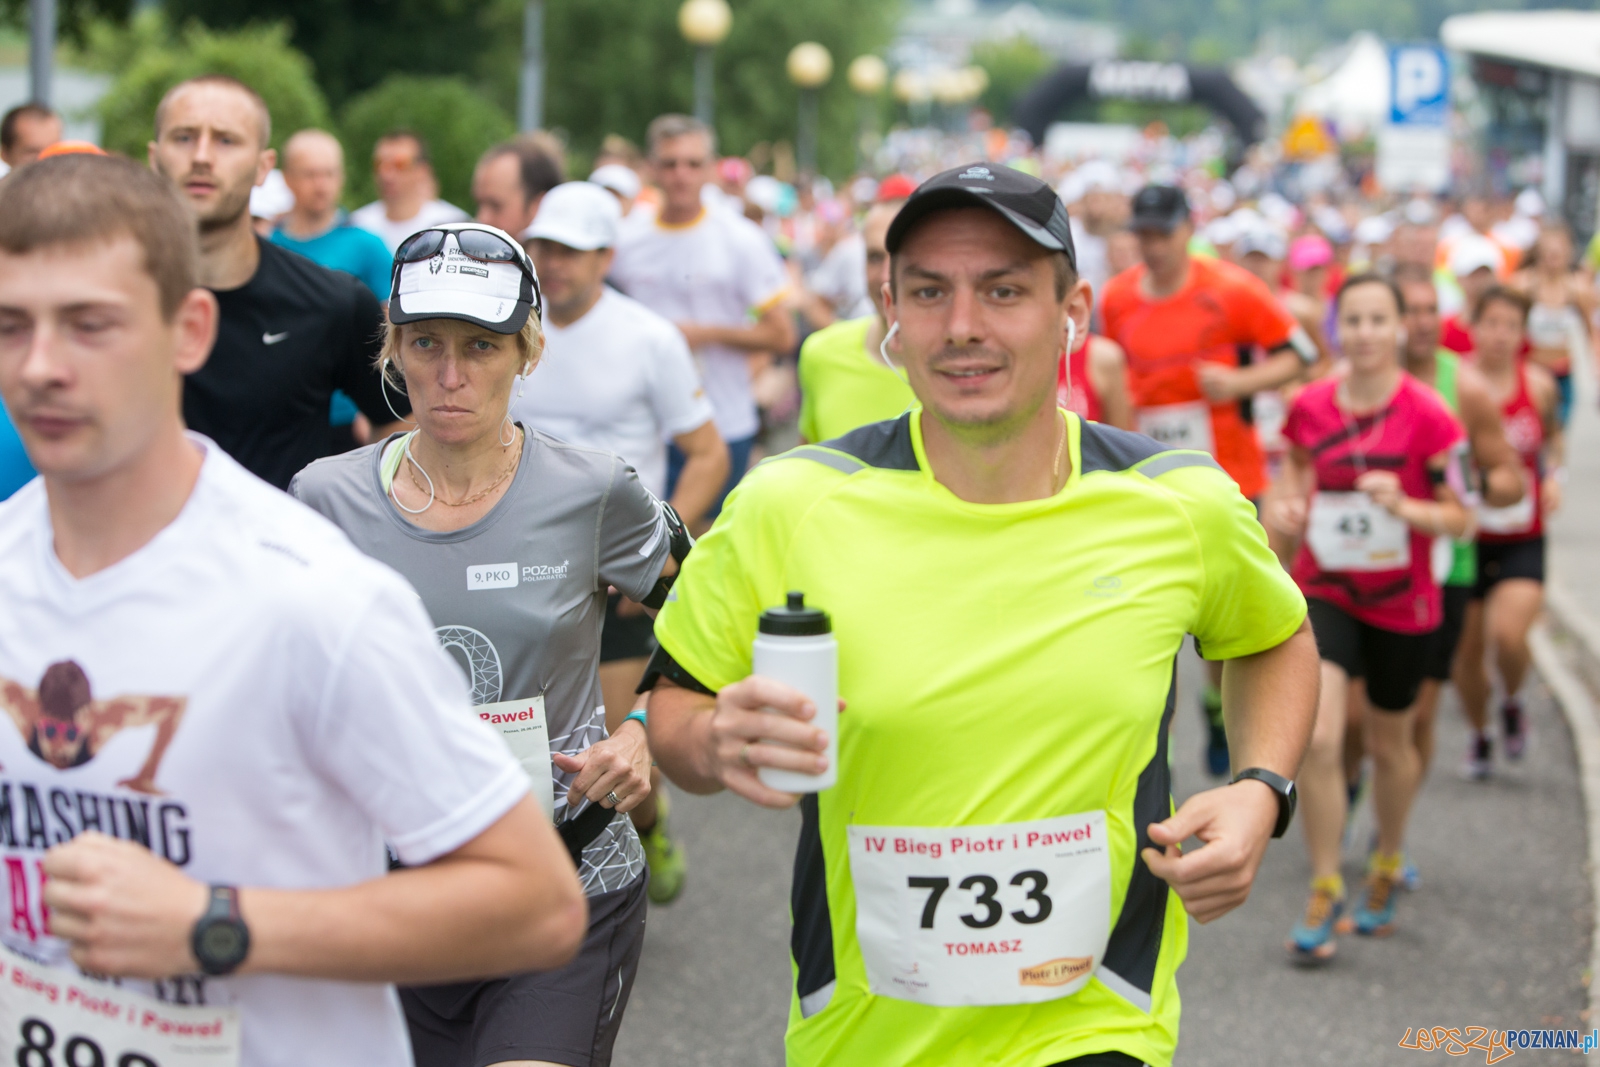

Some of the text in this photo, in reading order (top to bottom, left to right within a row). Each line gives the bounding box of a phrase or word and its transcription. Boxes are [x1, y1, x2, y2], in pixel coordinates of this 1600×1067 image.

[1396, 50, 1442, 112] P
[475, 570, 511, 583] 9. PKO
[479, 706, 534, 724] Paweł
[865, 823, 1093, 859] IV Bieg Piotr i Paweł
[907, 869, 1053, 929] 733
[944, 939, 1023, 956] TOMASZ
[11, 966, 60, 1002] Bieg
[67, 987, 120, 1019] Piotr
[16, 1015, 162, 1067] 89
